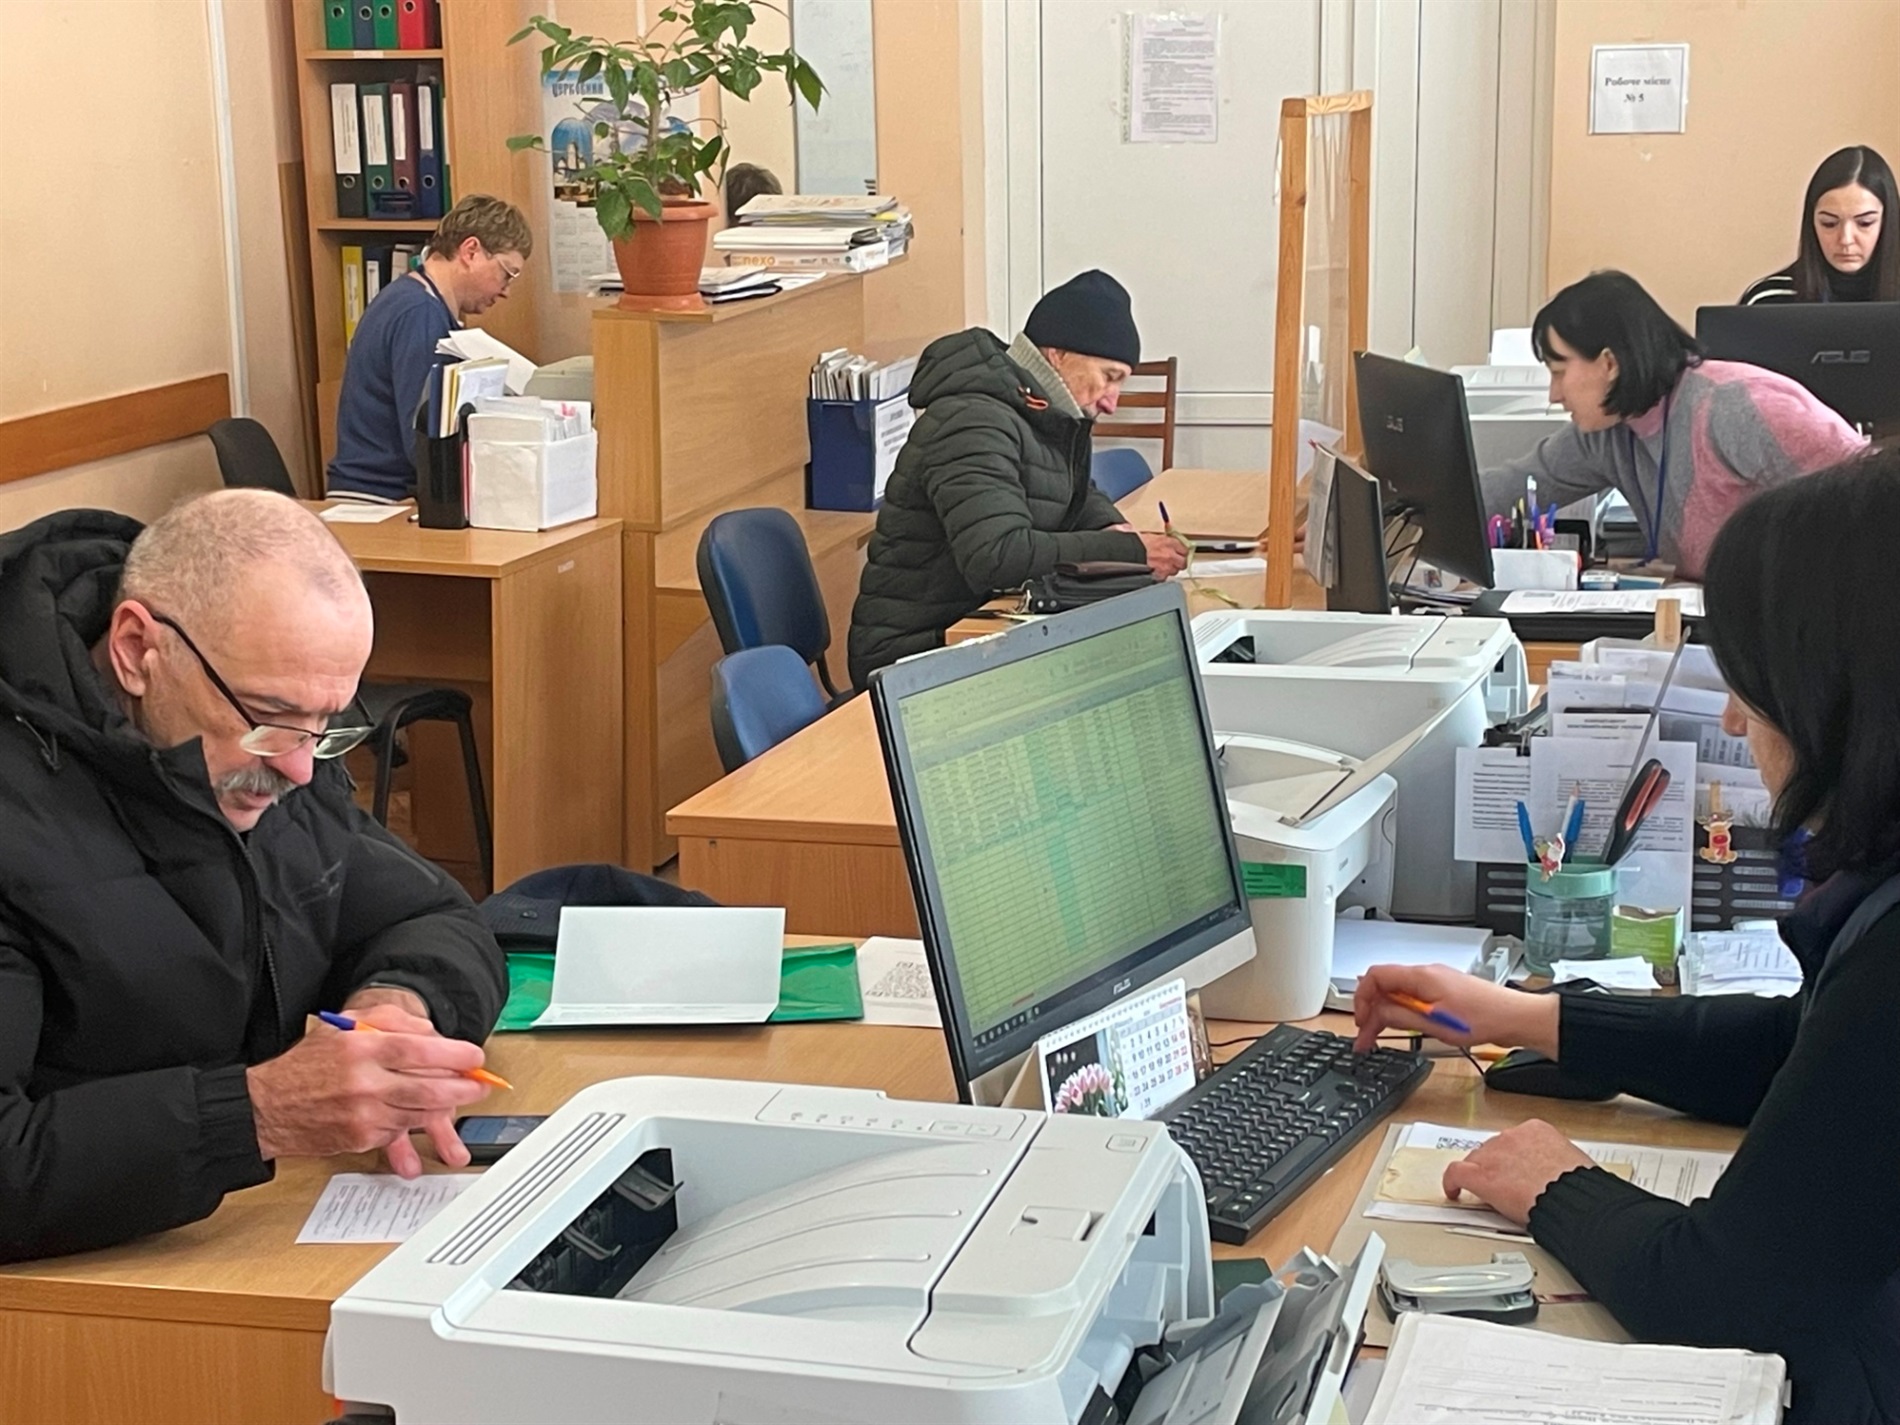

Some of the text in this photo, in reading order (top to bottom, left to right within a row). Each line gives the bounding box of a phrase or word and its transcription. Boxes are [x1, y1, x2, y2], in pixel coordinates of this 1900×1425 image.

[1605, 77, 1641, 86] Робоче
[1638, 93, 1644, 102] 5
[1810, 350, 1870, 364] ASUS
